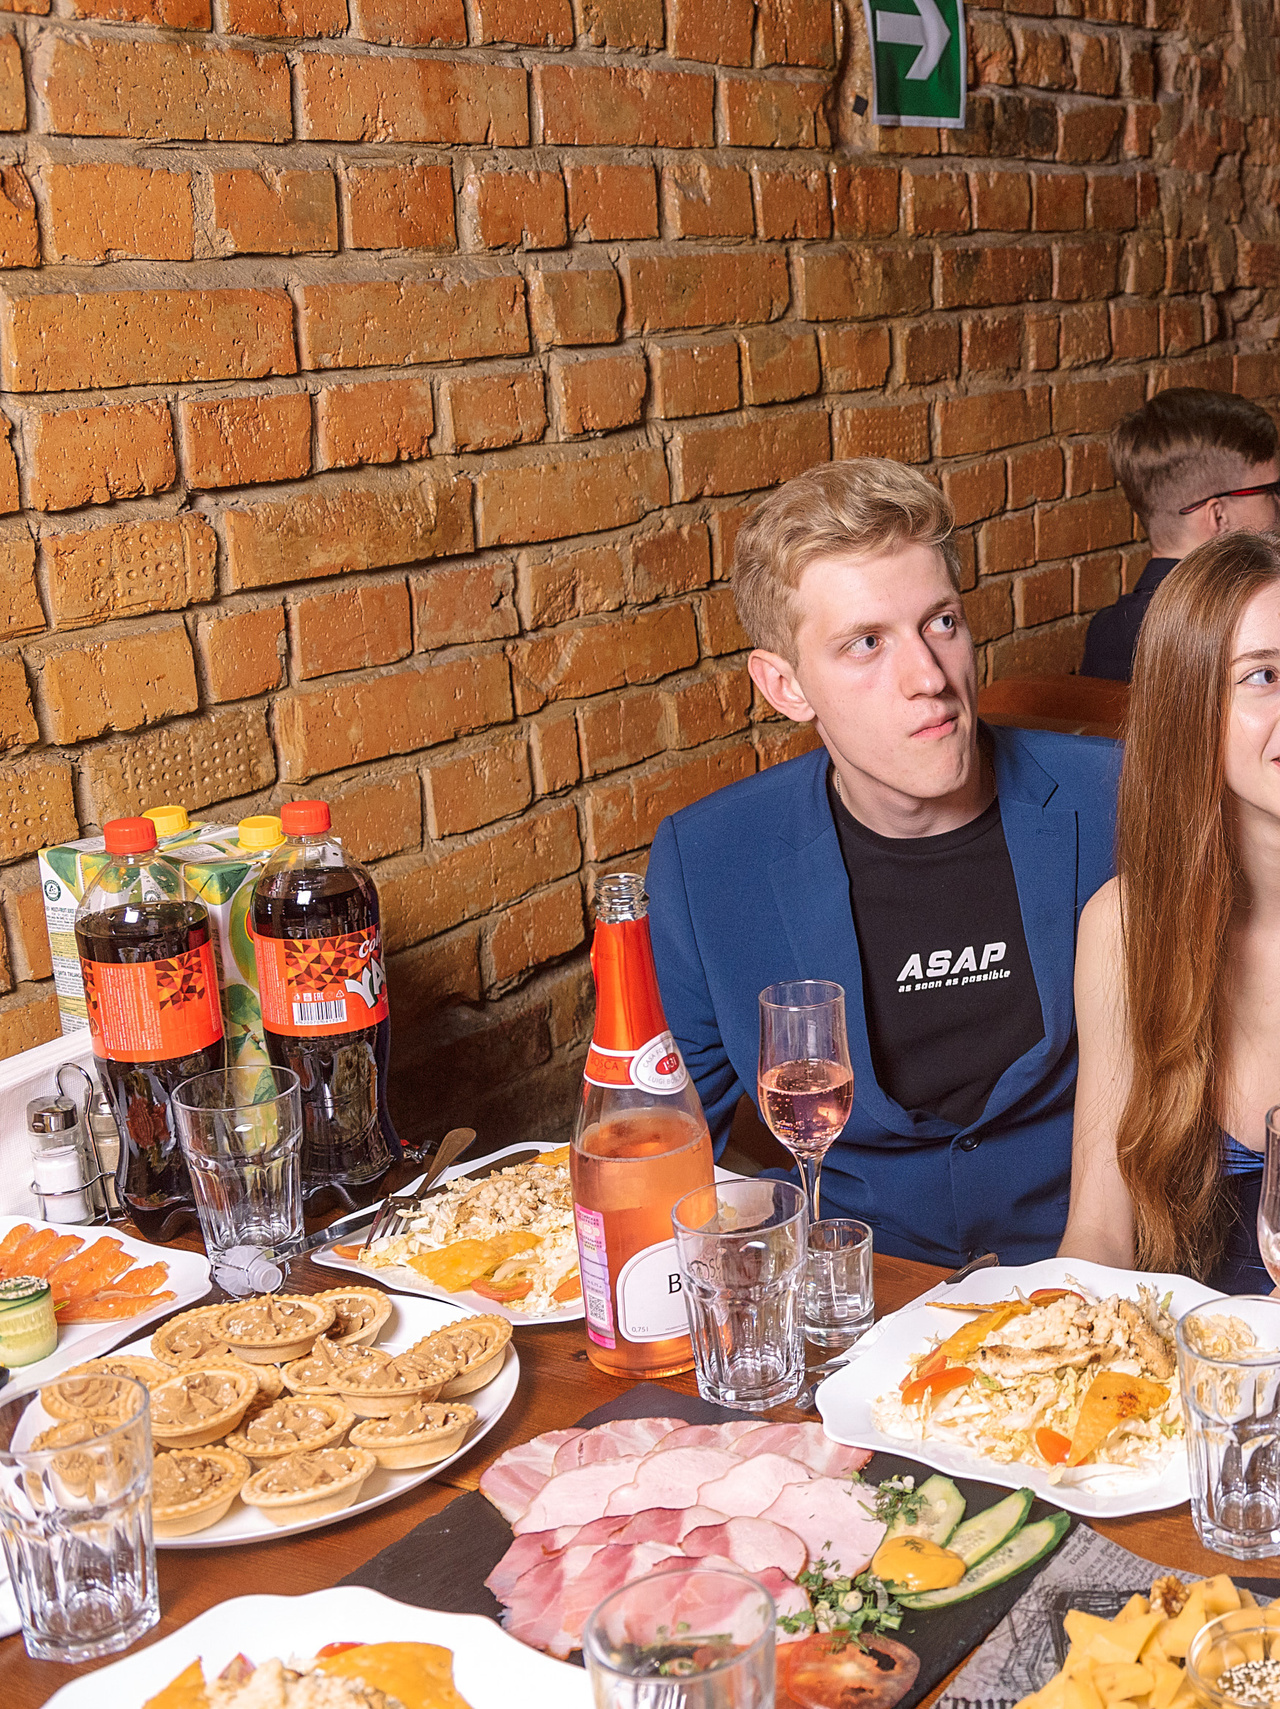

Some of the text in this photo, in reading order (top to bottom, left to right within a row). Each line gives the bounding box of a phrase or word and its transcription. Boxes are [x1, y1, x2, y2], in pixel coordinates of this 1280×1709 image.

[896, 941, 1007, 982] ASAP
[898, 968, 1011, 993] as soon as possible
